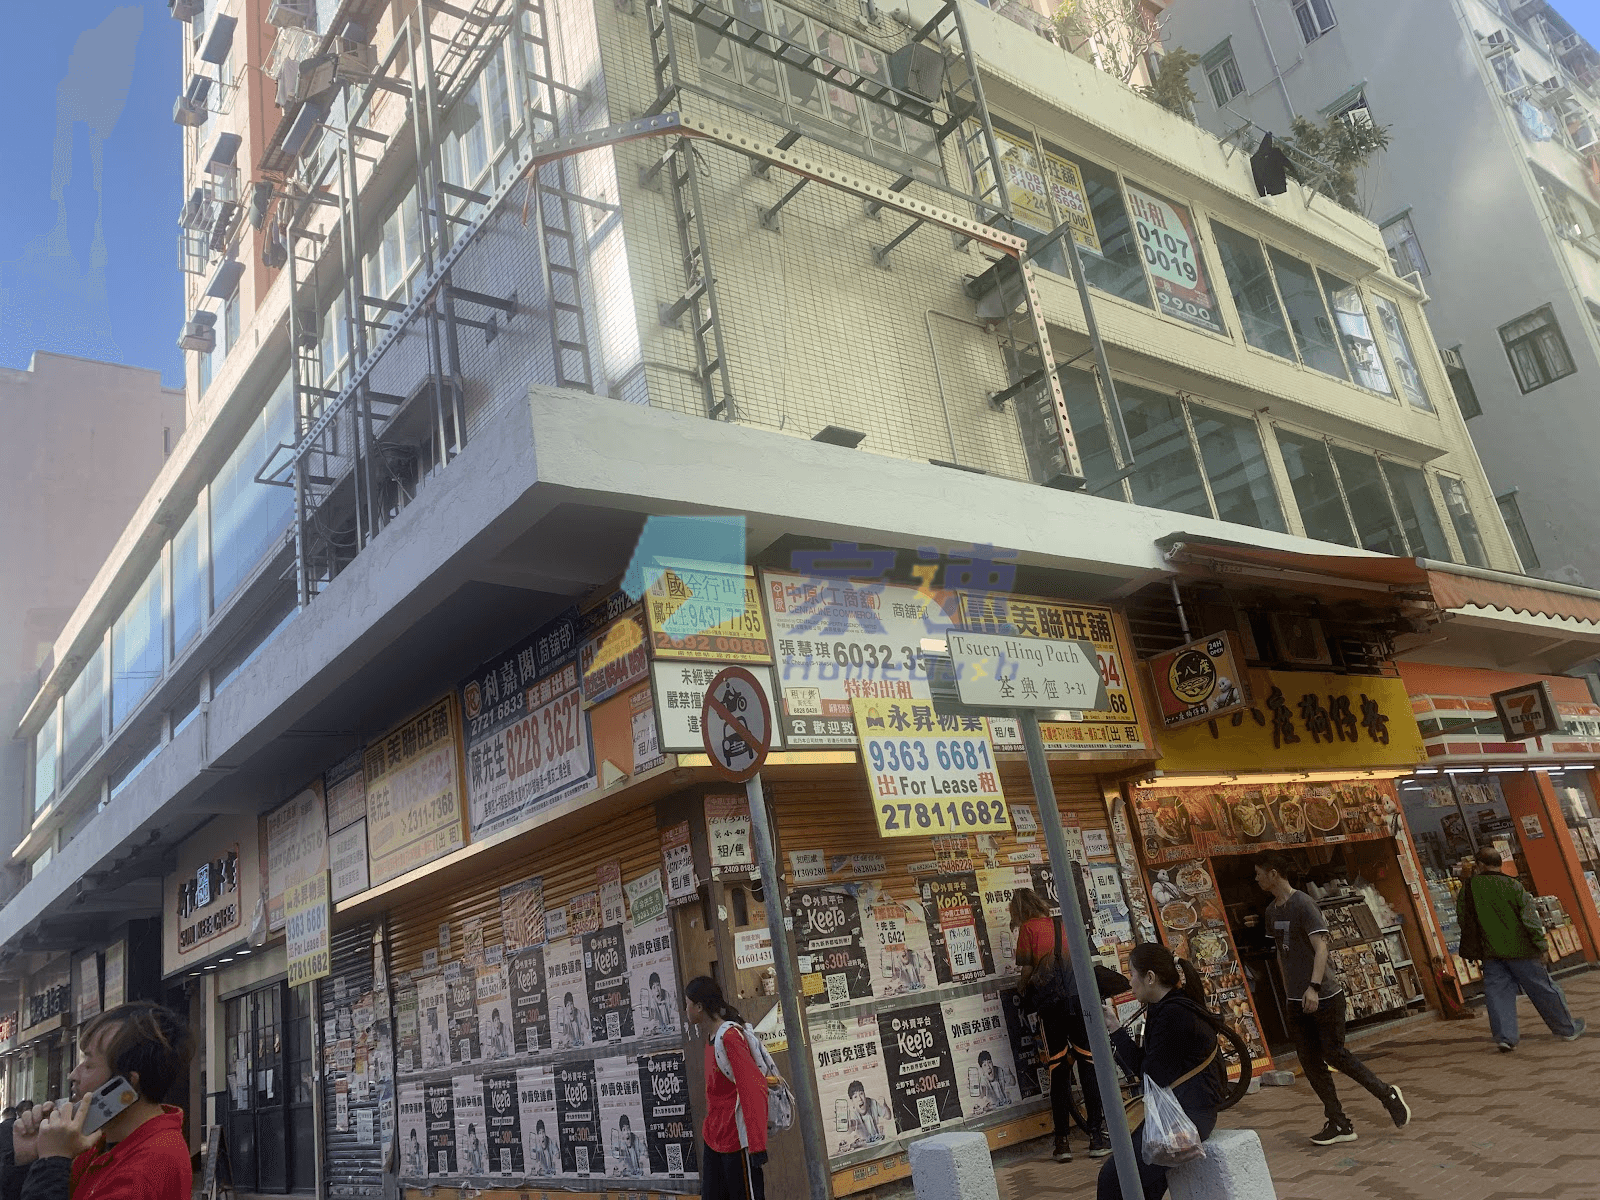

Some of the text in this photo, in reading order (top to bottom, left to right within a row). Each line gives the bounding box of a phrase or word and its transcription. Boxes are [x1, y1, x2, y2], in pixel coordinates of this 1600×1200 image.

[1136, 221, 1189, 259] 0107
[1143, 244, 1197, 282] 0019
[1158, 291, 1211, 321] 9900
[788, 604, 883, 621] CENTALINE COMMERCIAL
[1010, 604, 1113, 643] 美聯旺舖
[779, 638, 831, 659] 張慧琪
[833, 641, 895, 670] 6032
[952, 636, 1080, 668] Tsuen Hing Path
[1208, 639, 1222, 650] 24H
[1209, 646, 1224, 656] OPEN
[843, 678, 914, 700] 特約出租
[998, 675, 1060, 699] 荃興徑
[498, 692, 523, 720] 6833
[506, 714, 542, 782] 8228
[543, 690, 582, 762] 3627
[994, 725, 1017, 739] 租/售
[868, 739, 991, 772] 9363 6681
[877, 771, 998, 797] 出 For Lease 租
[881, 799, 1006, 830] 27811682
[717, 843, 745, 858] 租/售
[287, 902, 326, 941] 9363 6681
[303, 935, 320, 951] Lease
[887, 930, 906, 944] 6421
[289, 951, 328, 983] 27811682
[594, 947, 619, 975] KeeTa
[736, 950, 773, 965] 61601431
[517, 967, 538, 993] KeeTa
[952, 1015, 1001, 1039] 外賣免運費
[818, 1041, 878, 1067] 外賣免運費
[897, 1028, 934, 1057] KeeTa
[564, 1082, 588, 1108] KeeTa
[651, 1072, 680, 1101] KeeTa
[915, 1073, 939, 1094] $300
[491, 1089, 511, 1114] KeeTa
